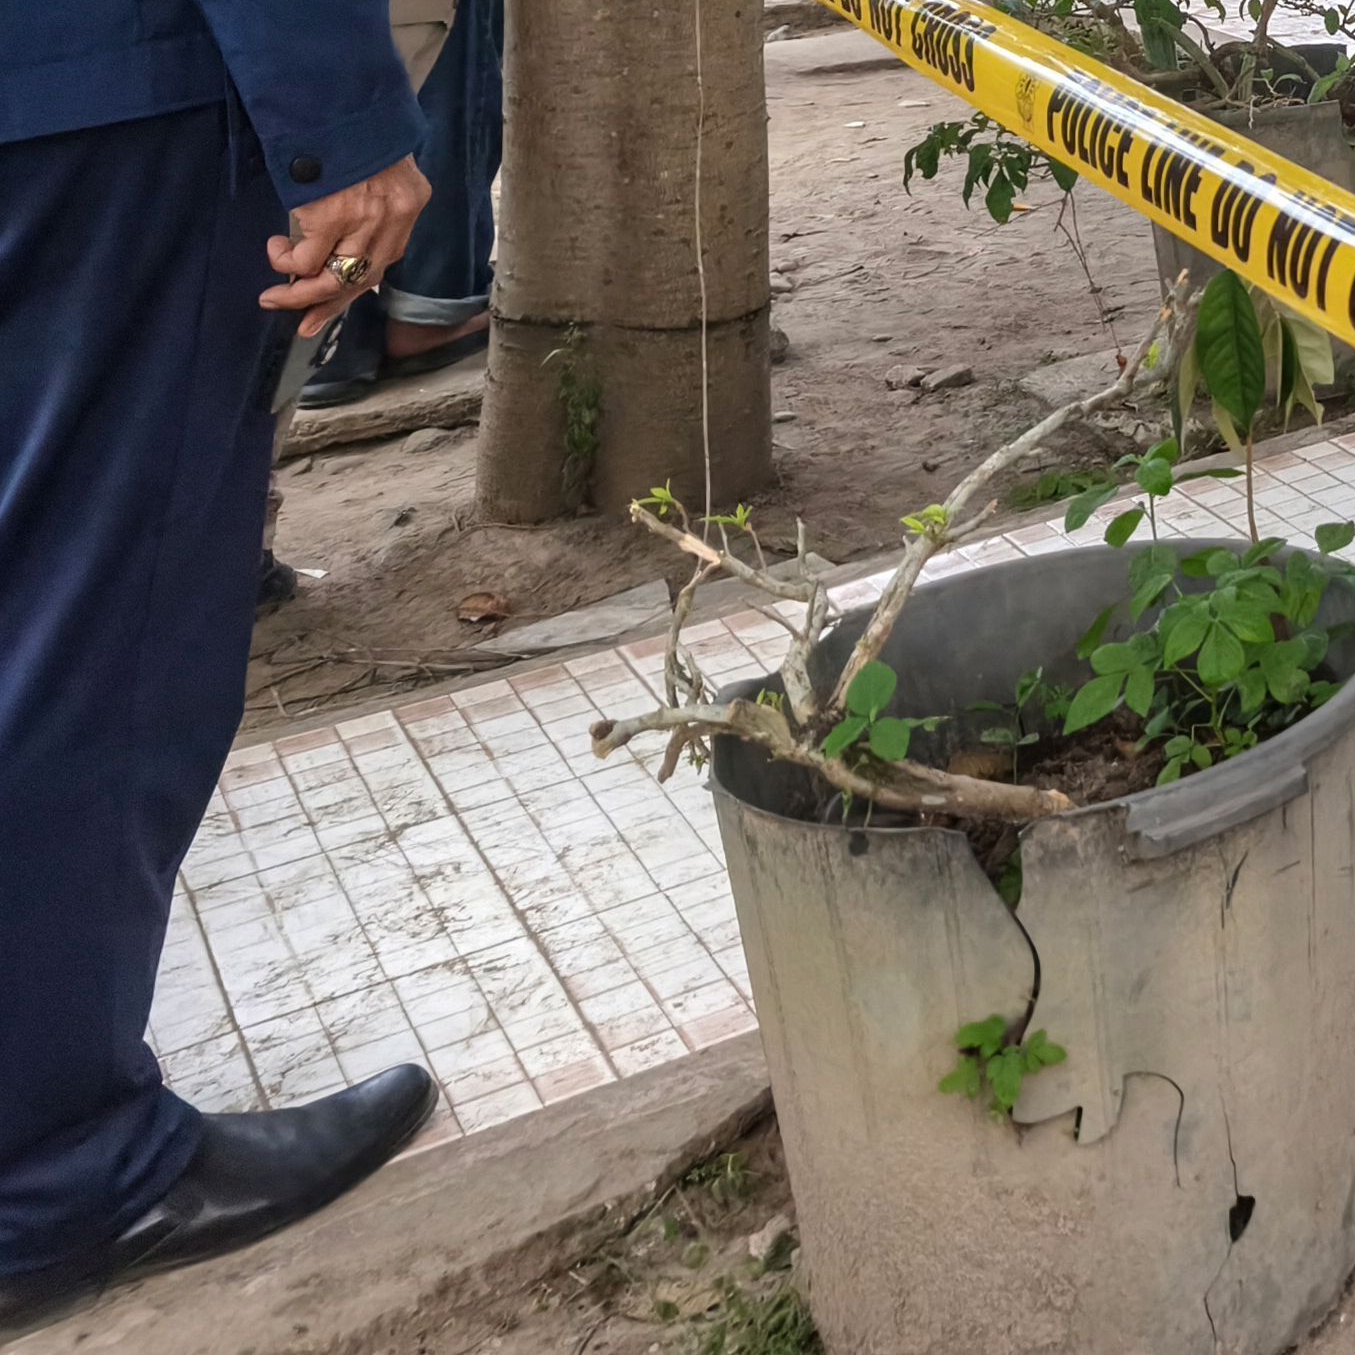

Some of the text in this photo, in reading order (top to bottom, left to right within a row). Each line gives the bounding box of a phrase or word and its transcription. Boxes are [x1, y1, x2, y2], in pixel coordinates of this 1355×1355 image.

[911, 1, 997, 92] CROSS
[1046, 68, 1157, 189] POLICE
[1141, 122, 1226, 231] LINE
[1211, 159, 1277, 263] DO
